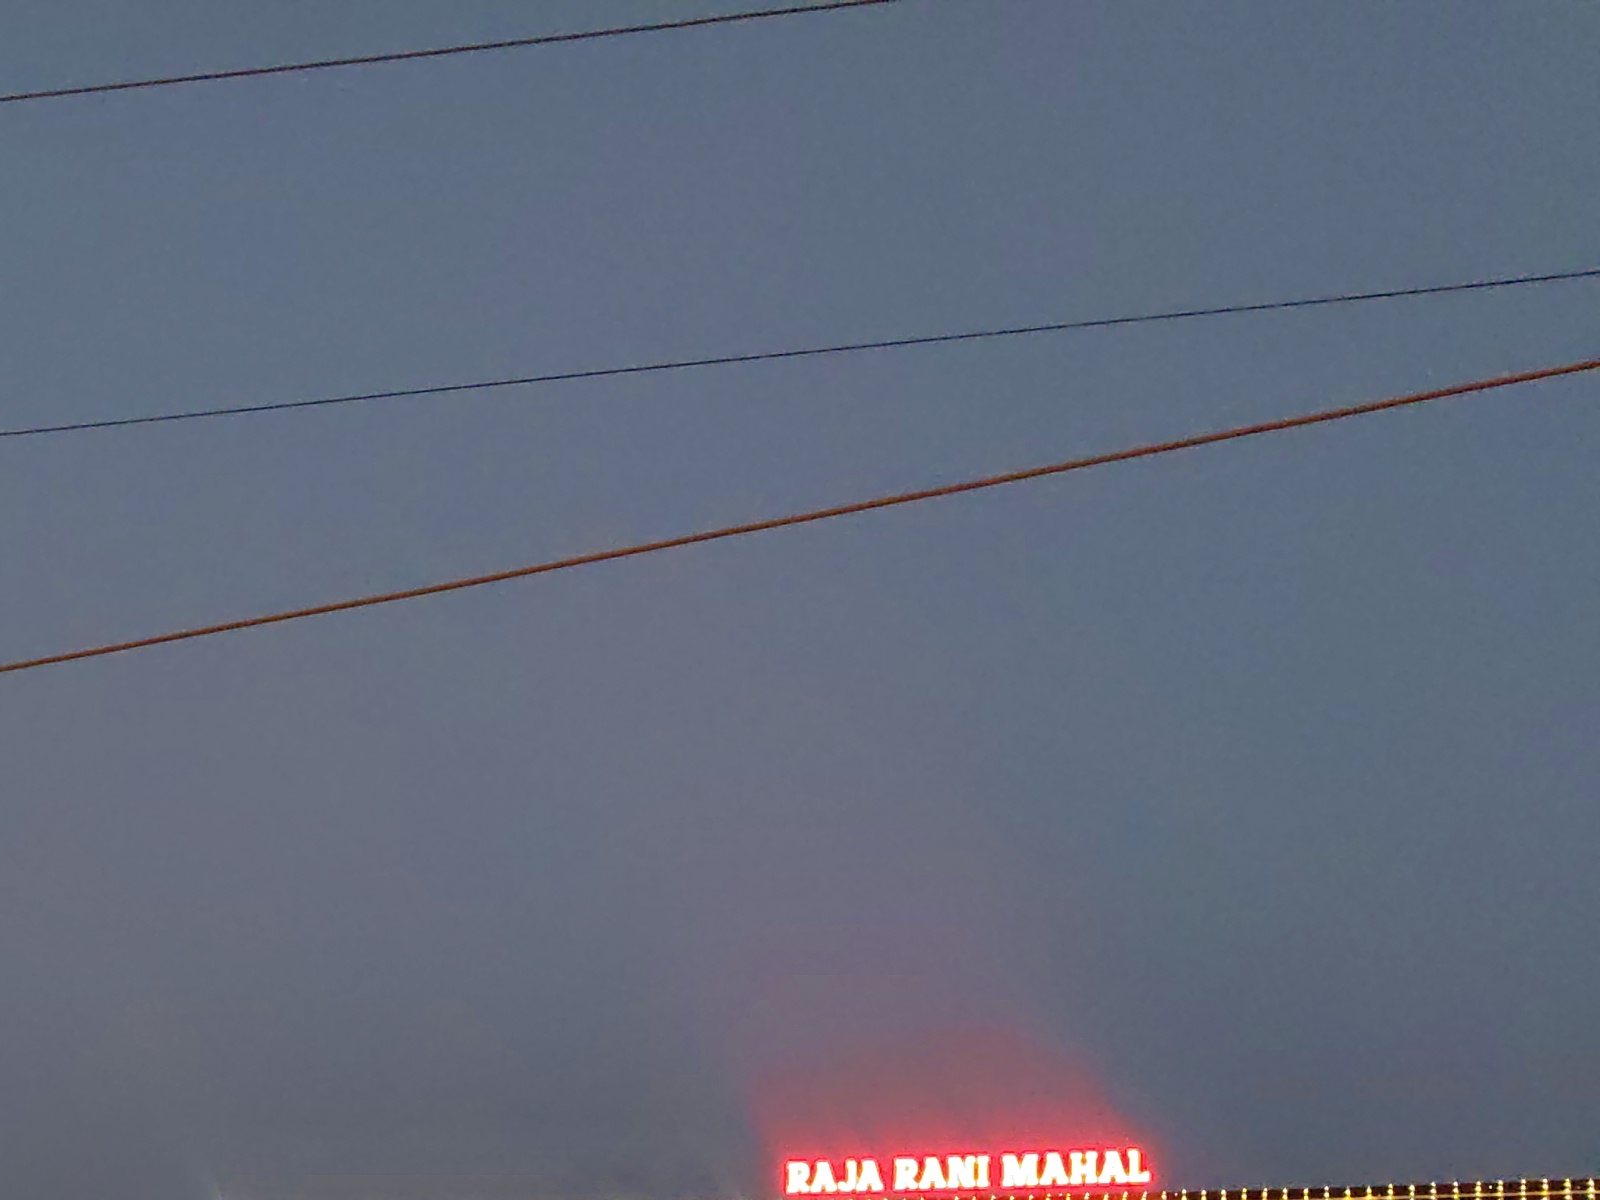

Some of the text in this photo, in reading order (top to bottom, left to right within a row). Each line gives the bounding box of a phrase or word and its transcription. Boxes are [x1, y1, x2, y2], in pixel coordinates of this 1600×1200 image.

[786, 1148, 1151, 1194] RAJA RANI MAHAL
